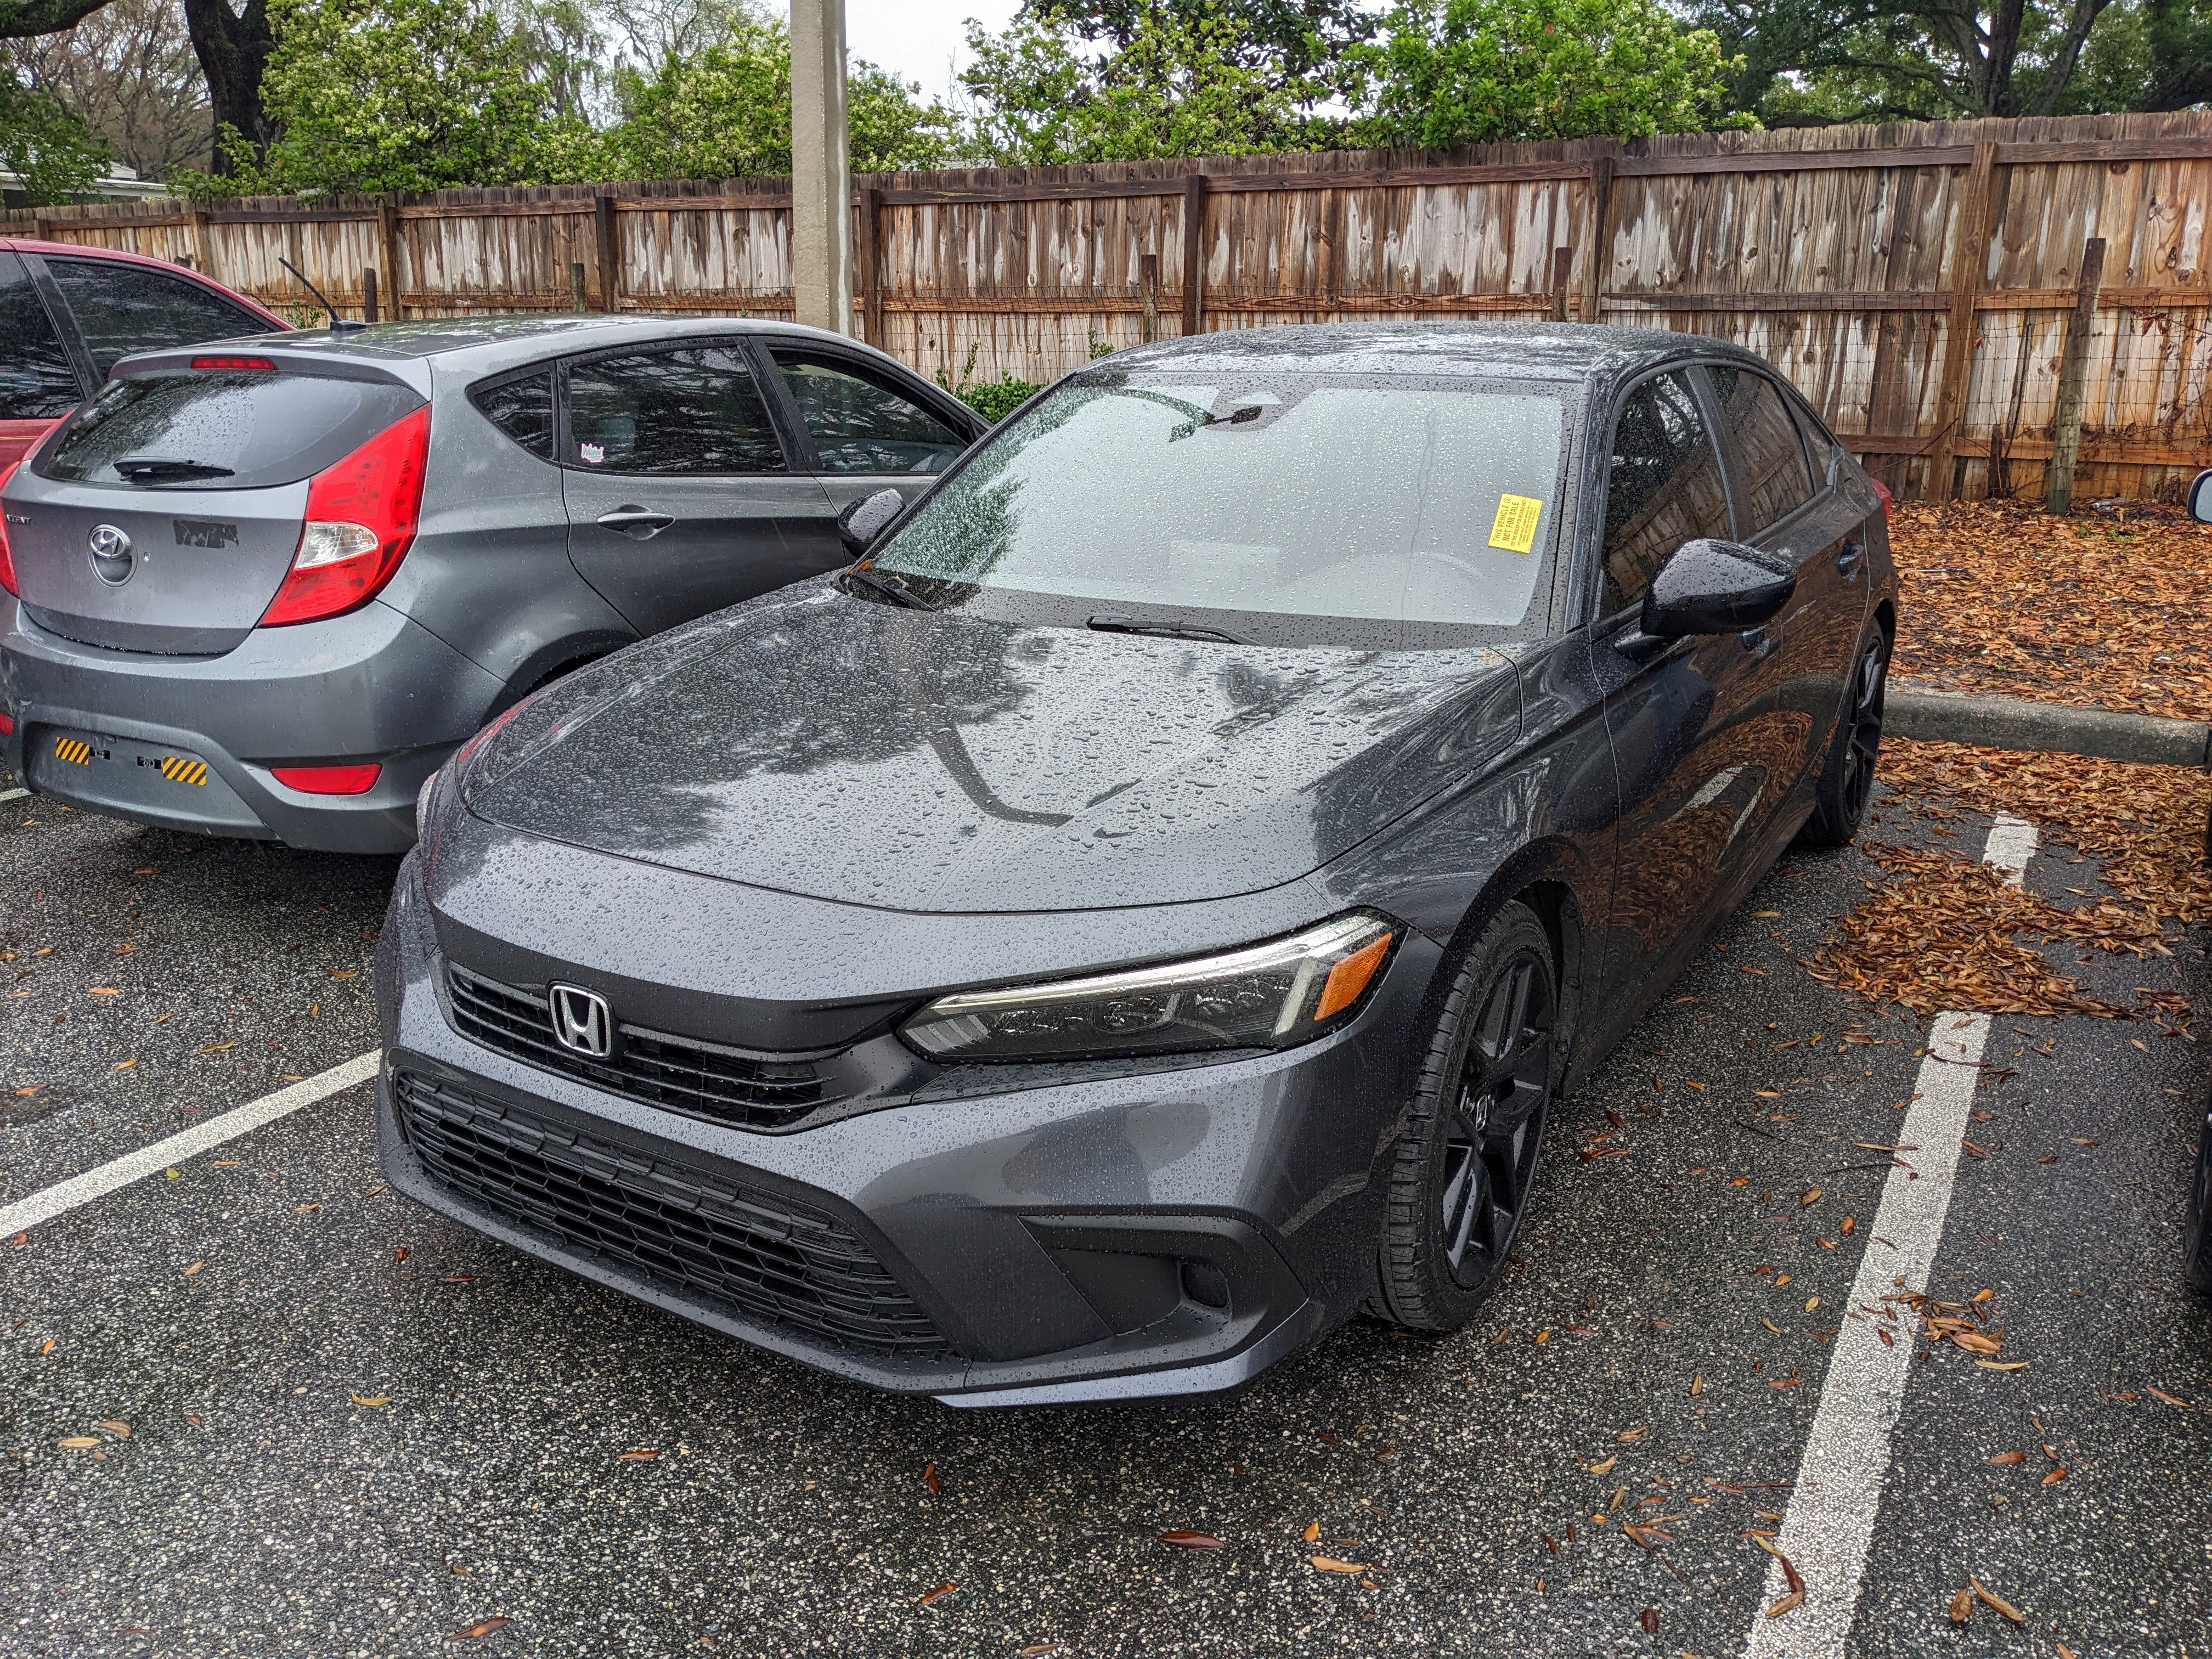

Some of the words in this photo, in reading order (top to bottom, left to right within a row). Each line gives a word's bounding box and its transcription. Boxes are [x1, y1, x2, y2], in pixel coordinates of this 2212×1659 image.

[1509, 502, 1519, 516] SALE
[1497, 505, 1509, 527] VEHICLE
[1506, 517, 1515, 528] FOR
[1493, 529, 1502, 541] THIS
[1503, 529, 1511, 541] NOT
